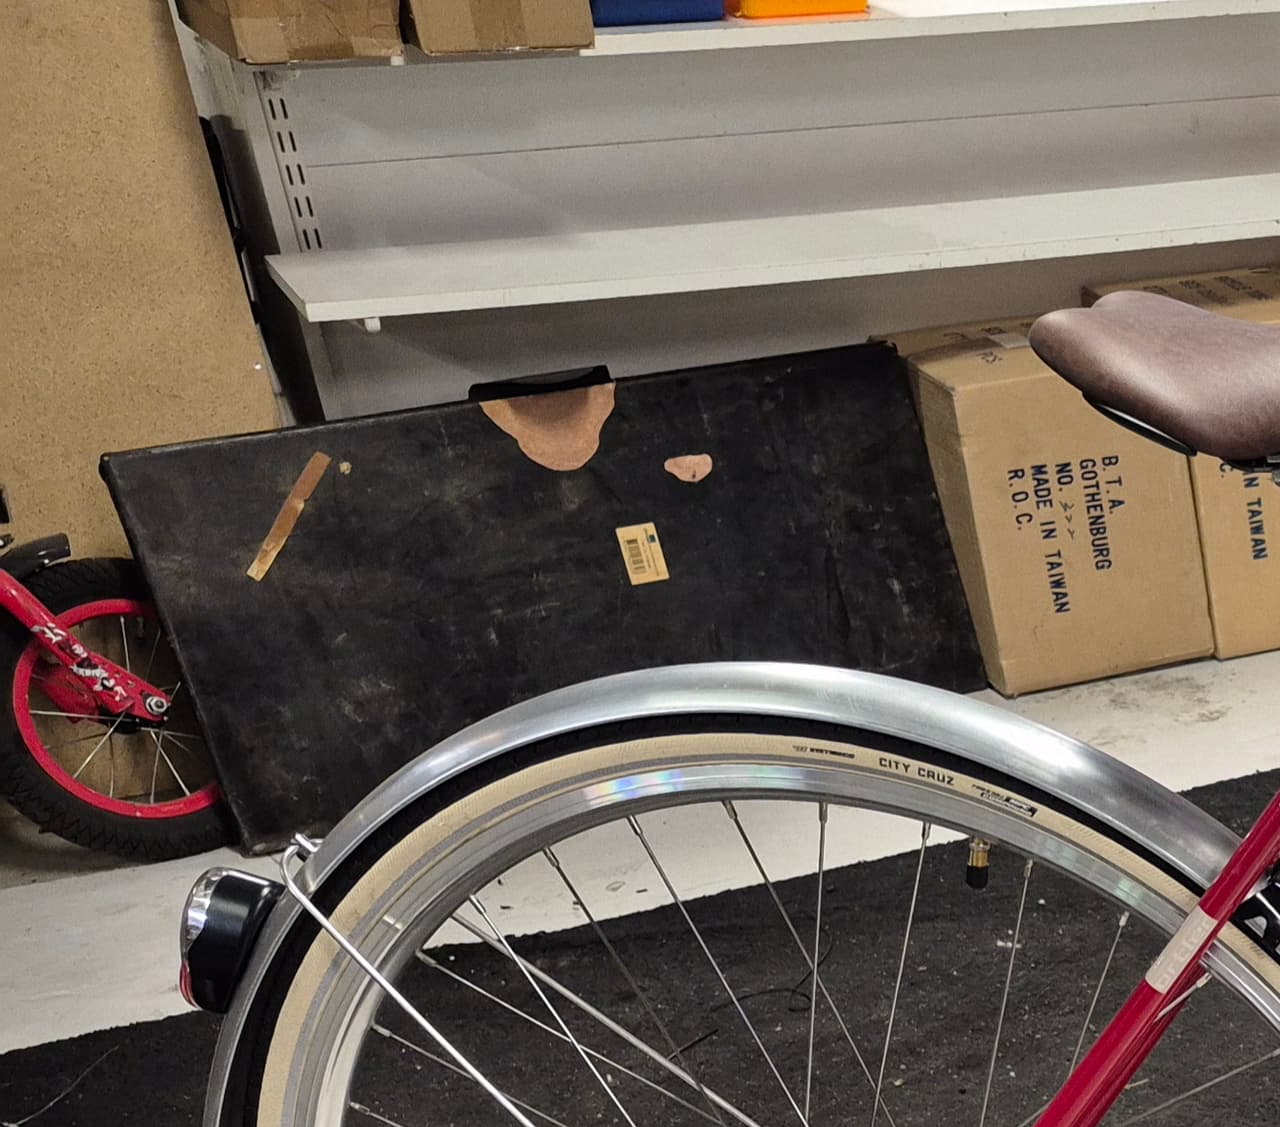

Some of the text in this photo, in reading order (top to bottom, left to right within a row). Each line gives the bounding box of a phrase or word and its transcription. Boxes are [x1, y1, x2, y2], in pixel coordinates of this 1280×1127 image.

[1031, 464, 1053, 510] MADE
[1055, 462, 1074, 492] NO.
[1040, 521, 1057, 540] IN
[1079, 458, 1112, 570] GOTHENBURG
[1246, 497, 1268, 560] TAIWAN
[1045, 549, 1071, 613] TAIWAN
[878, 757, 956, 786] CITY CRUZ
